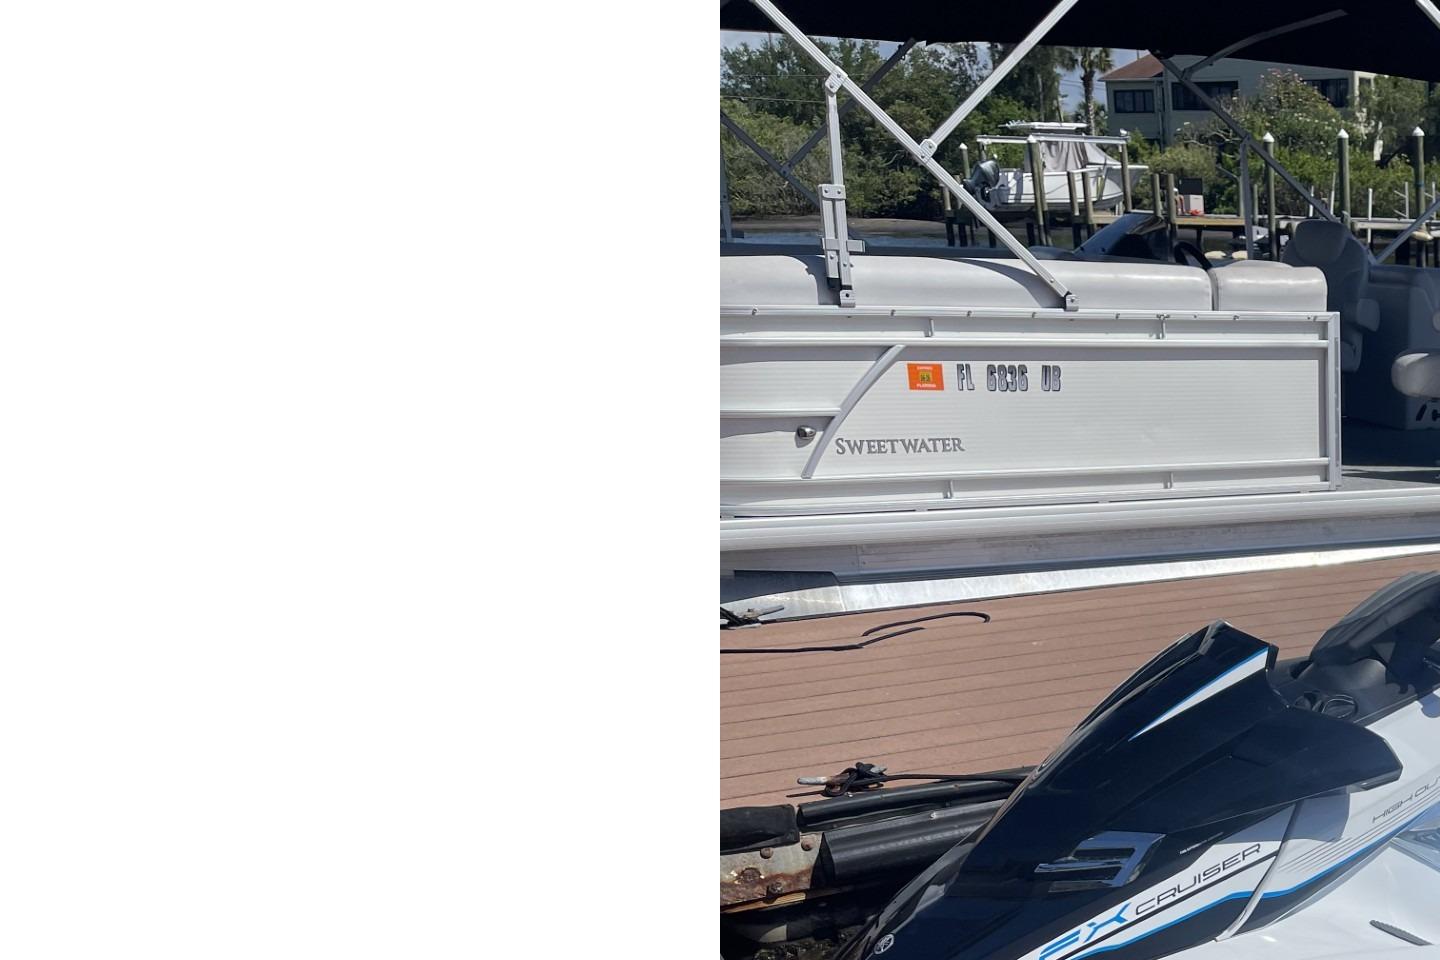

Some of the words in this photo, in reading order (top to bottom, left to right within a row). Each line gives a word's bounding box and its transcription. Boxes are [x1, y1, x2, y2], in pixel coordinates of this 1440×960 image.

[957, 363, 976, 391] FL
[986, 364, 1029, 392] 6836
[1040, 364, 1062, 392] UB
[1134, 842, 1261, 917] CRUISER
